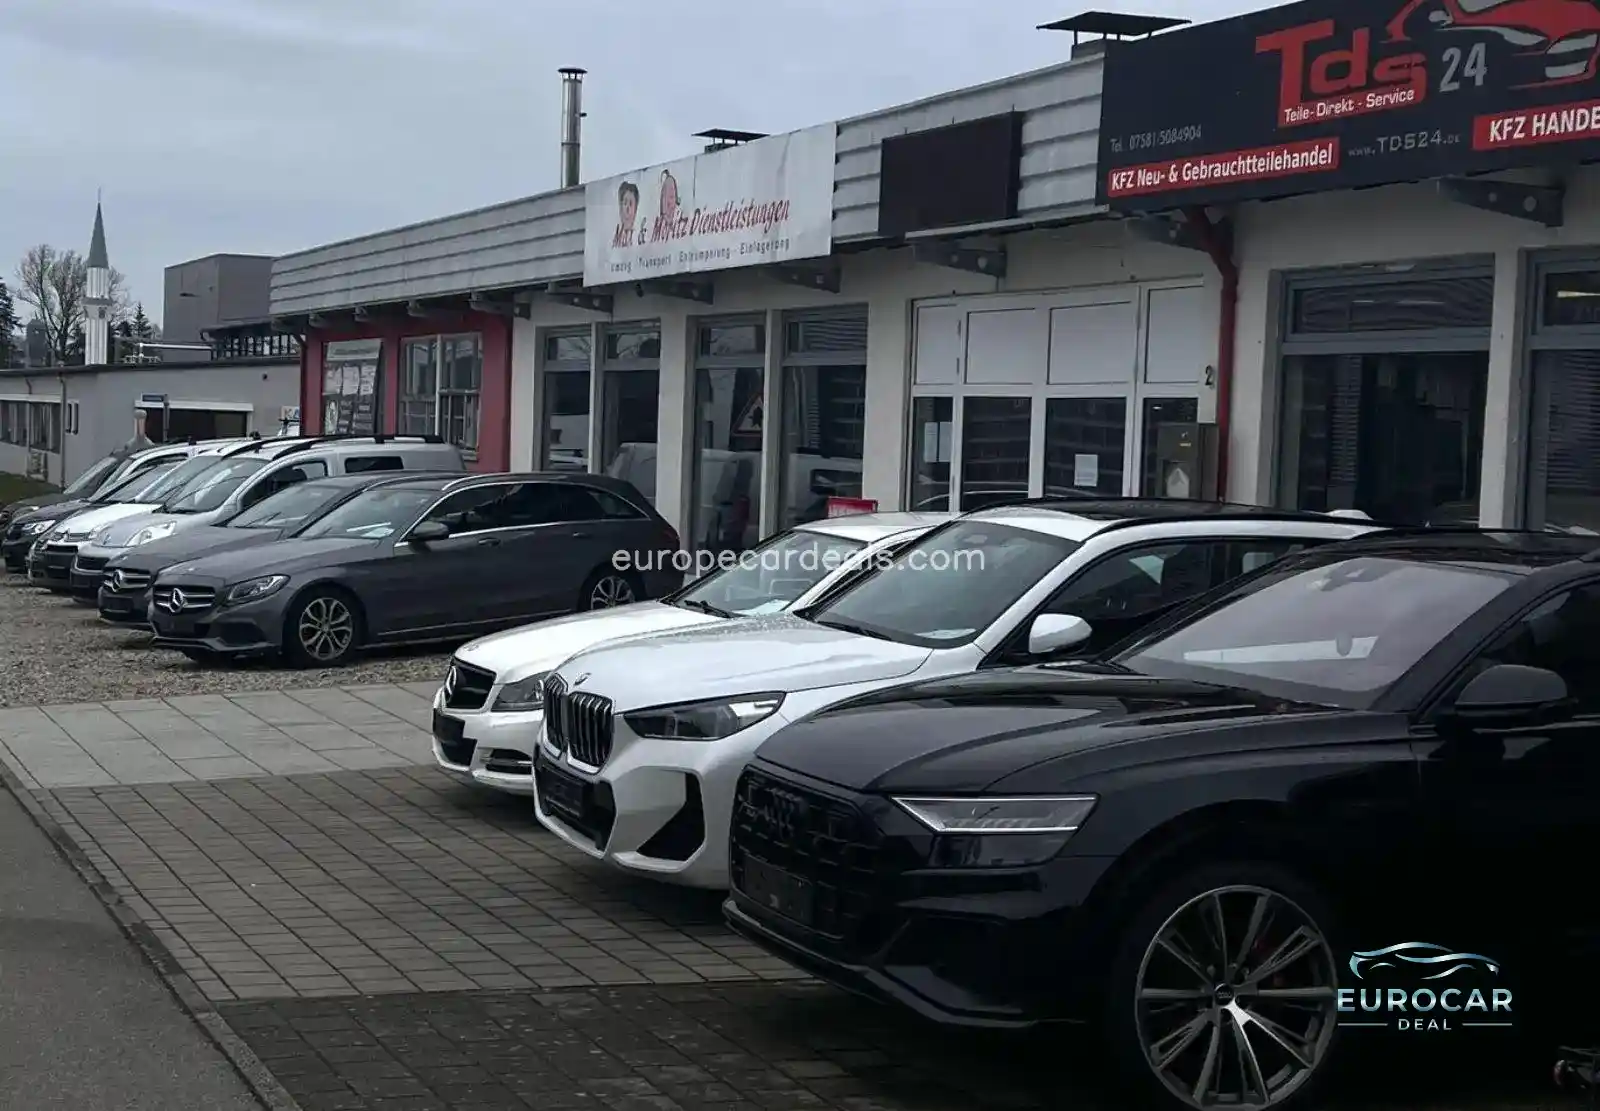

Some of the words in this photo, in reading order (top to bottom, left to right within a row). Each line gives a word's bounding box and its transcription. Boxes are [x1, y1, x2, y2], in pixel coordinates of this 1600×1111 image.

[1255, 19, 1427, 127] Tds
[1439, 42, 1487, 93] 24
[1317, 99, 1355, 118] Direkt
[1366, 87, 1415, 109] Service
[1489, 116, 1527, 143] KFZ
[1111, 170, 1134, 191] KFZ
[1137, 168, 1165, 188] Neu-
[1168, 164, 1178, 183] &
[1182, 142, 1333, 182] Gebrauchtteilehandel
[688, 197, 790, 235] Dienstleistungen
[1205, 365, 1214, 386] 2
